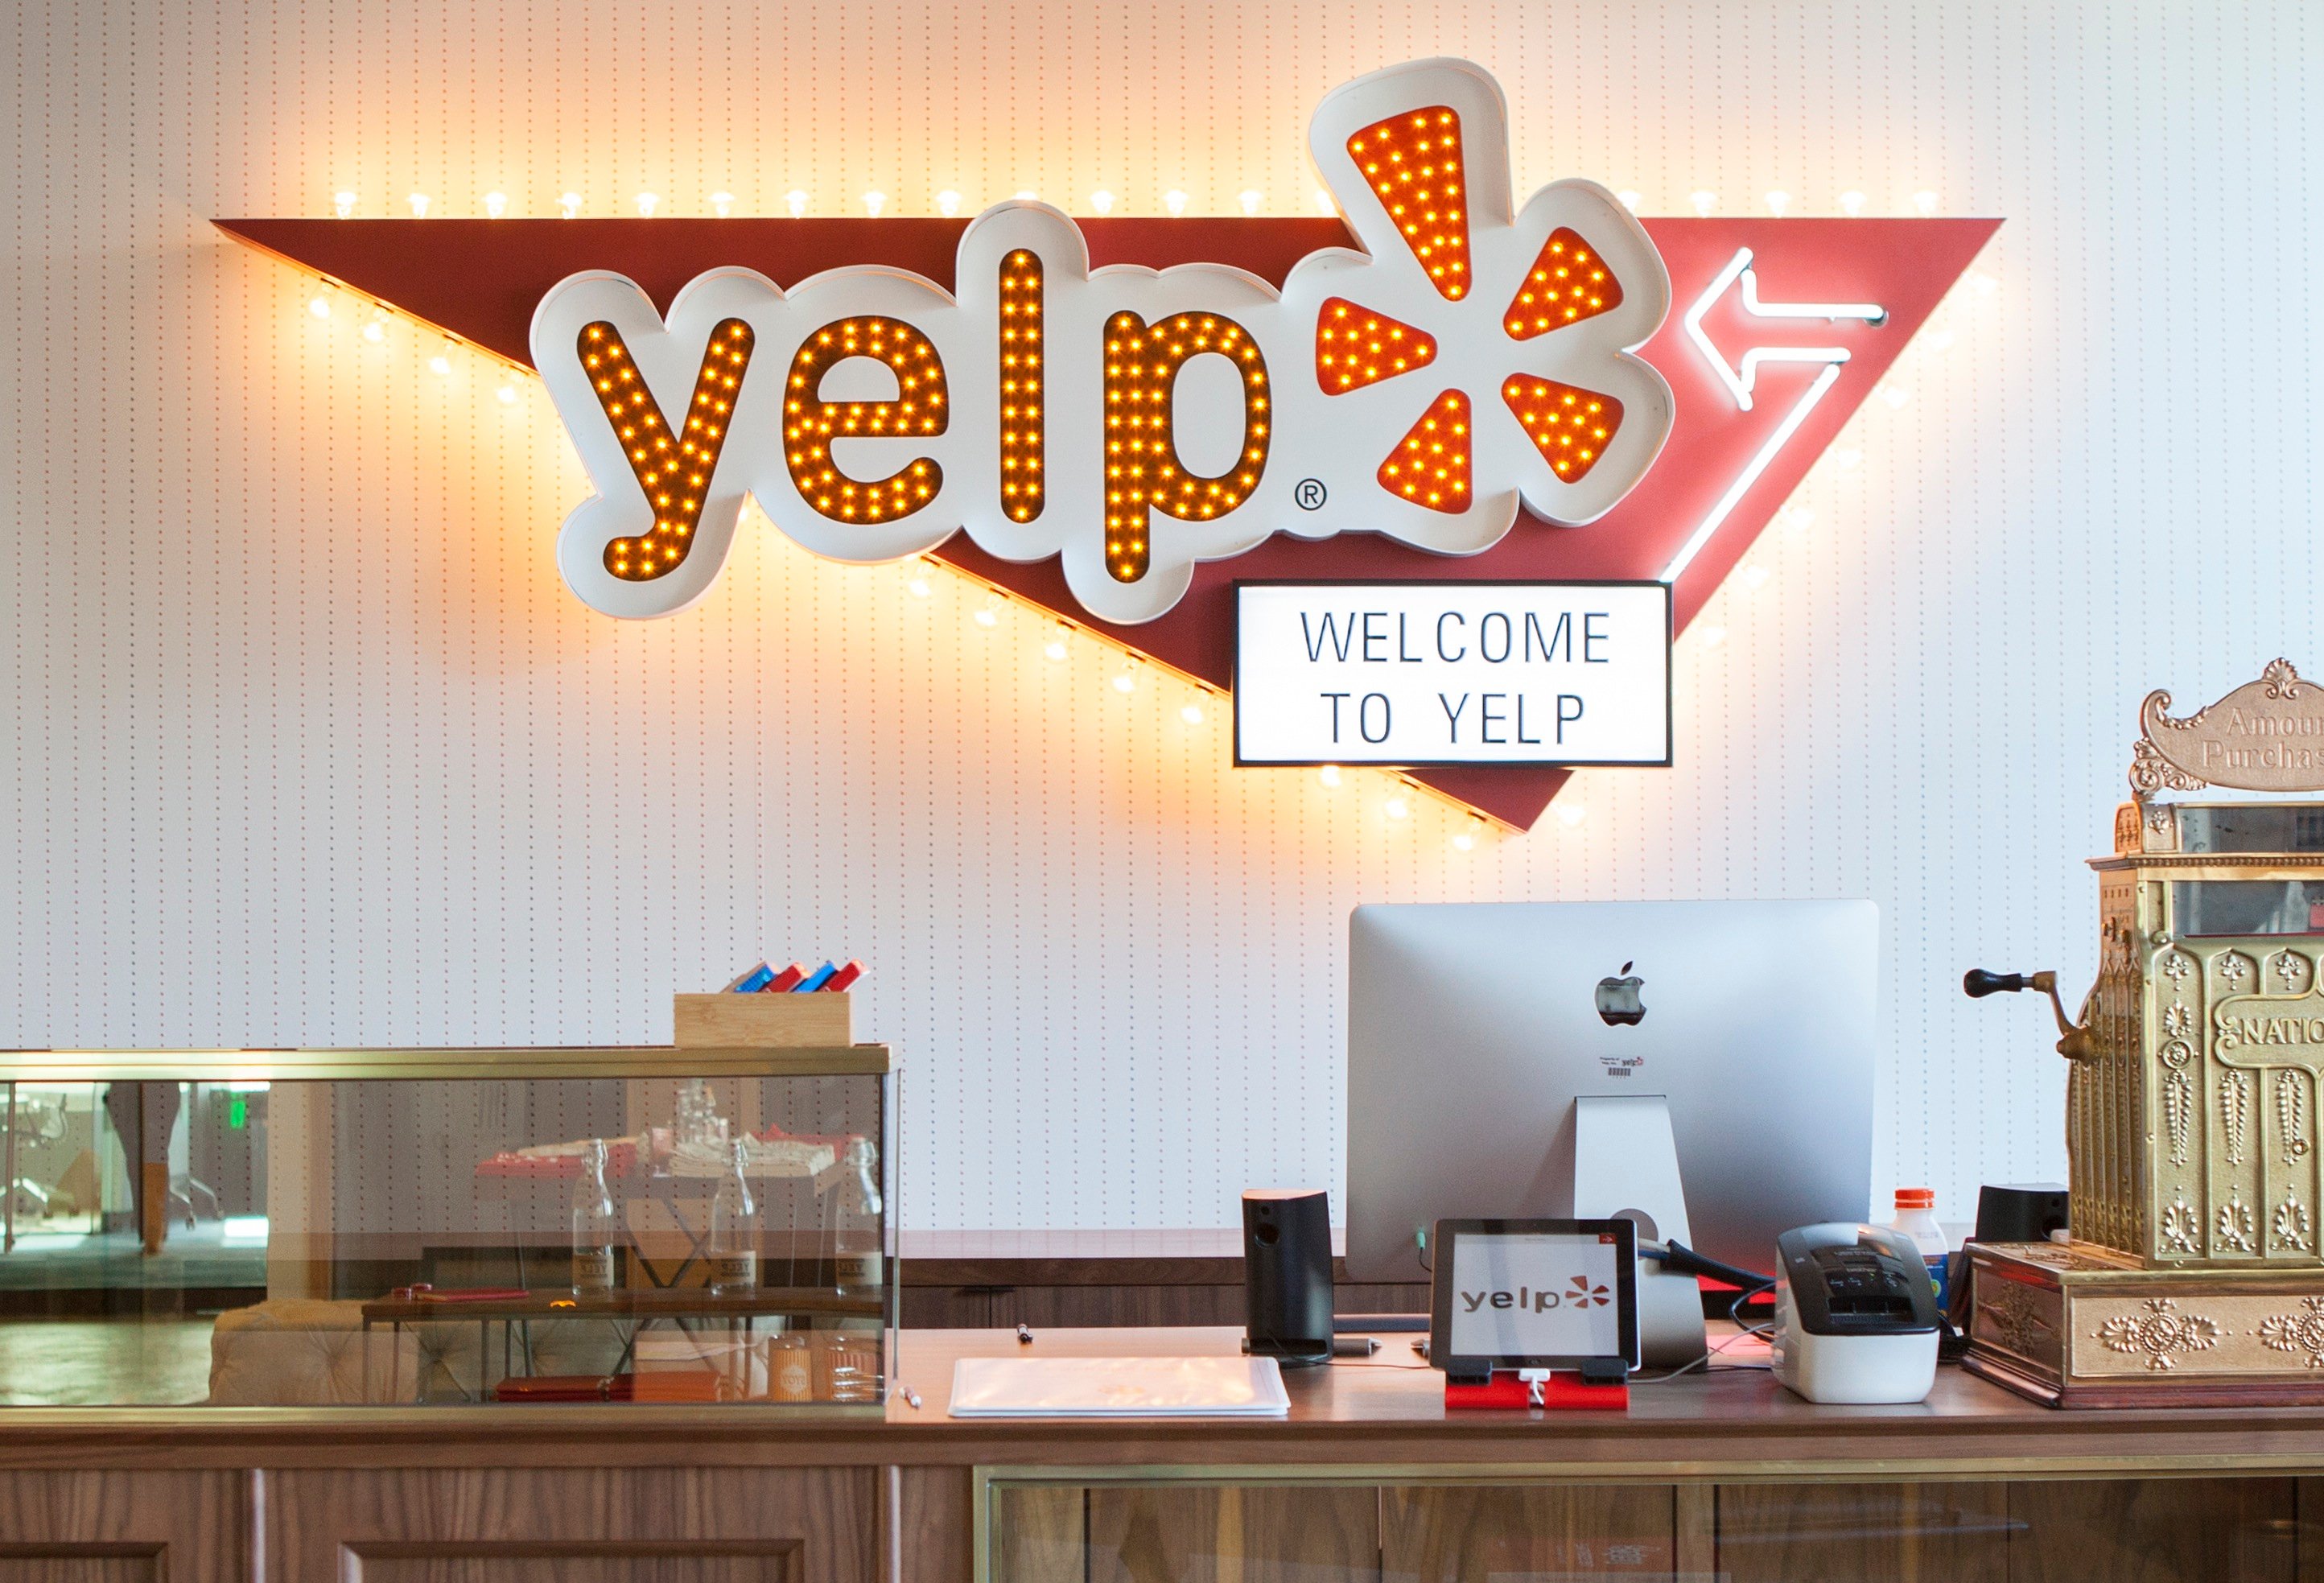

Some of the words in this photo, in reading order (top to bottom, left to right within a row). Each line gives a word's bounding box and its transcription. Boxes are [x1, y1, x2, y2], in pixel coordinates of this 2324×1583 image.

[577, 248, 1271, 583] yelp
[1300, 612, 1610, 664] WELCOME
[1321, 693, 1392, 744] TO
[1438, 693, 1584, 744] YELP
[2240, 1017, 2324, 1045] NATIO
[1461, 1286, 1560, 1313] yelp
